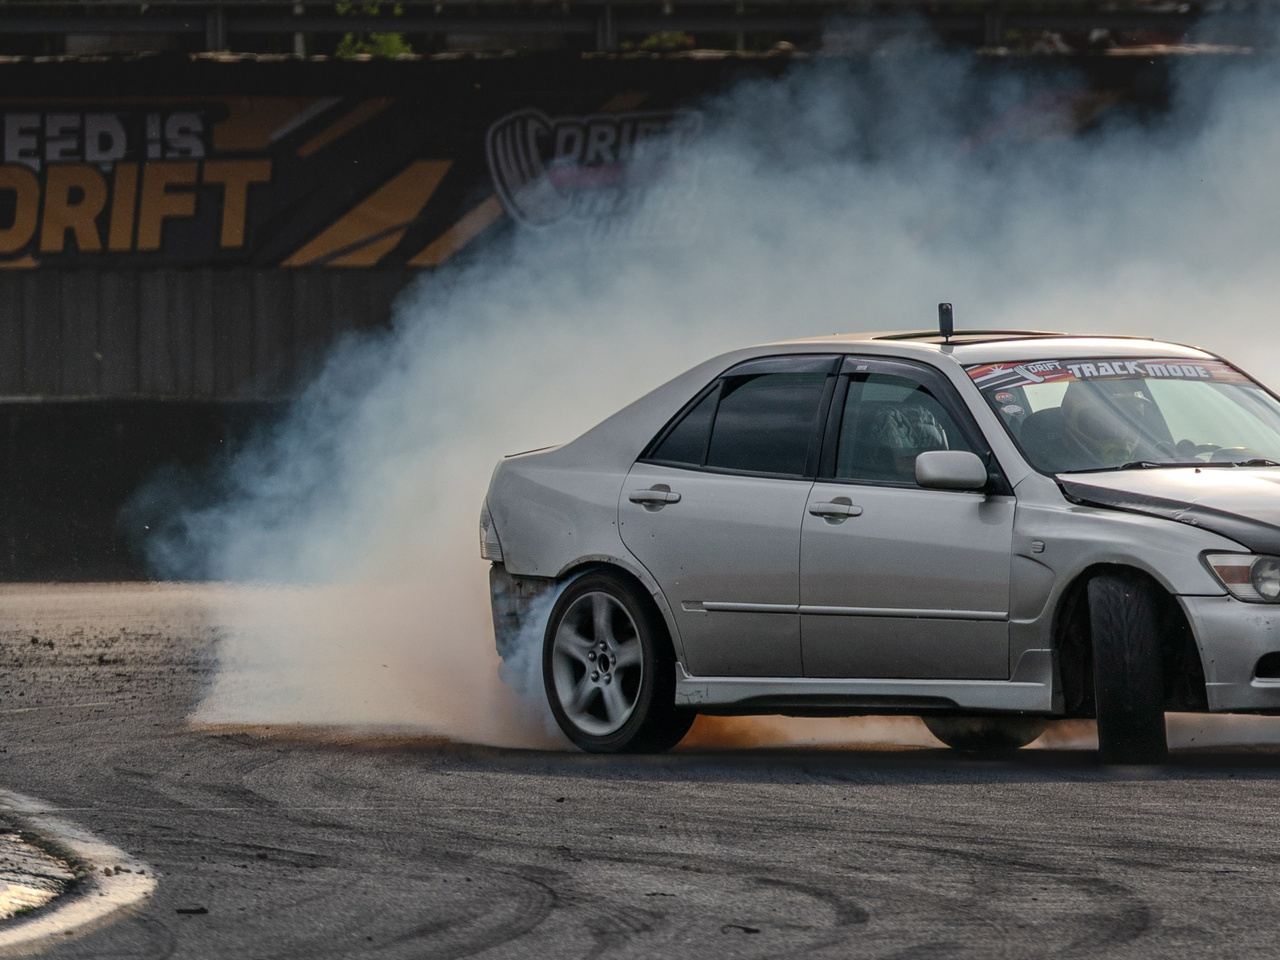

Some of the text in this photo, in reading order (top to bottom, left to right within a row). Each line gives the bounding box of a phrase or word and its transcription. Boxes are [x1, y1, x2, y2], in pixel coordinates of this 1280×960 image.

[146, 112, 205, 158] IS
[1029, 361, 1062, 374] DRIFT
[1067, 361, 1147, 378] TRACK
